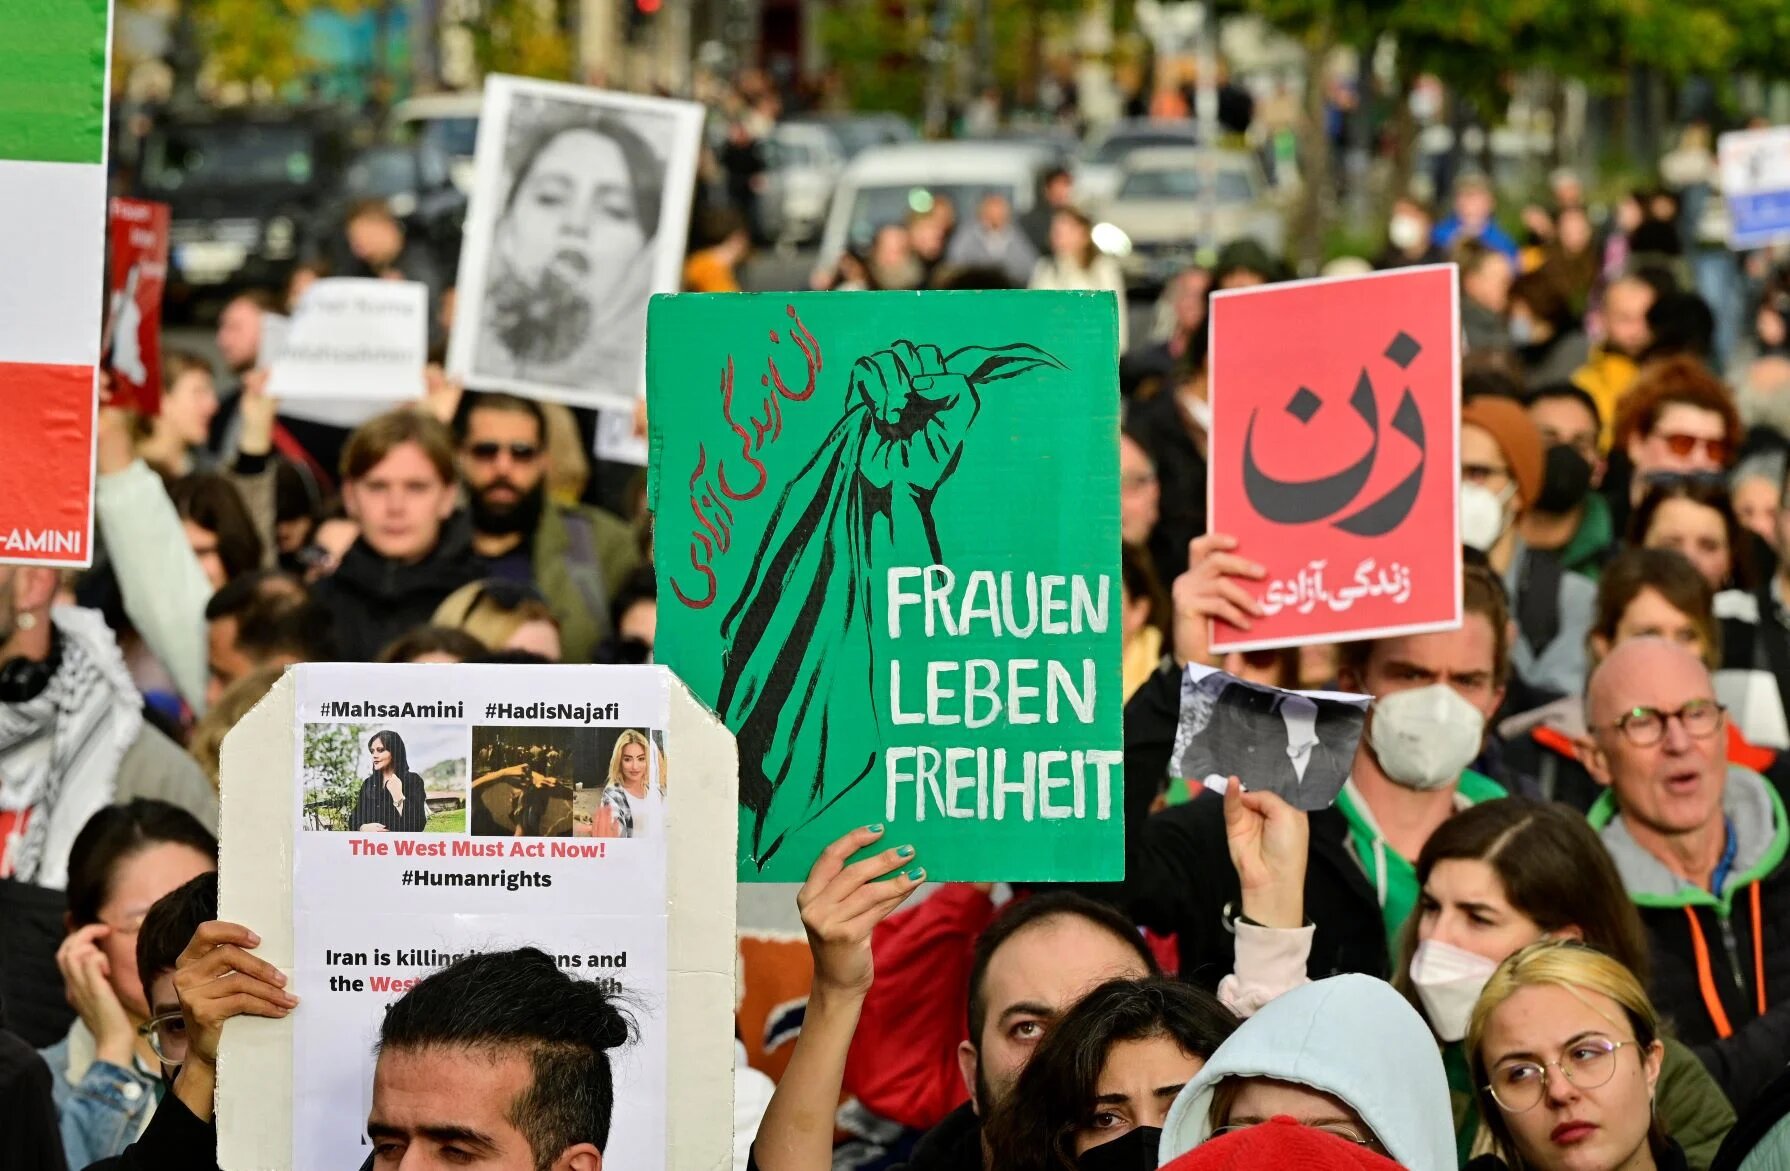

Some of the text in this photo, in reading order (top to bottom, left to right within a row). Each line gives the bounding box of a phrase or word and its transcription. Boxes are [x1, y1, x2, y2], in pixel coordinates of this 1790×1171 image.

[1241, 330, 1428, 538] زن
[887, 564, 1110, 639] FRAUEN
[890, 658, 1097, 729] LEBEN
[320, 700, 619, 724] #MahsaAmini #HadisNajafi
[885, 746, 1123, 822] FREIHEIT
[348, 839, 606, 859] The West Must Act Now!
[402, 869, 552, 889] #Humanrights
[326, 949, 367, 966] Iran
[374, 948, 391, 966] is
[587, 951, 627, 968] and
[329, 975, 364, 992] the
